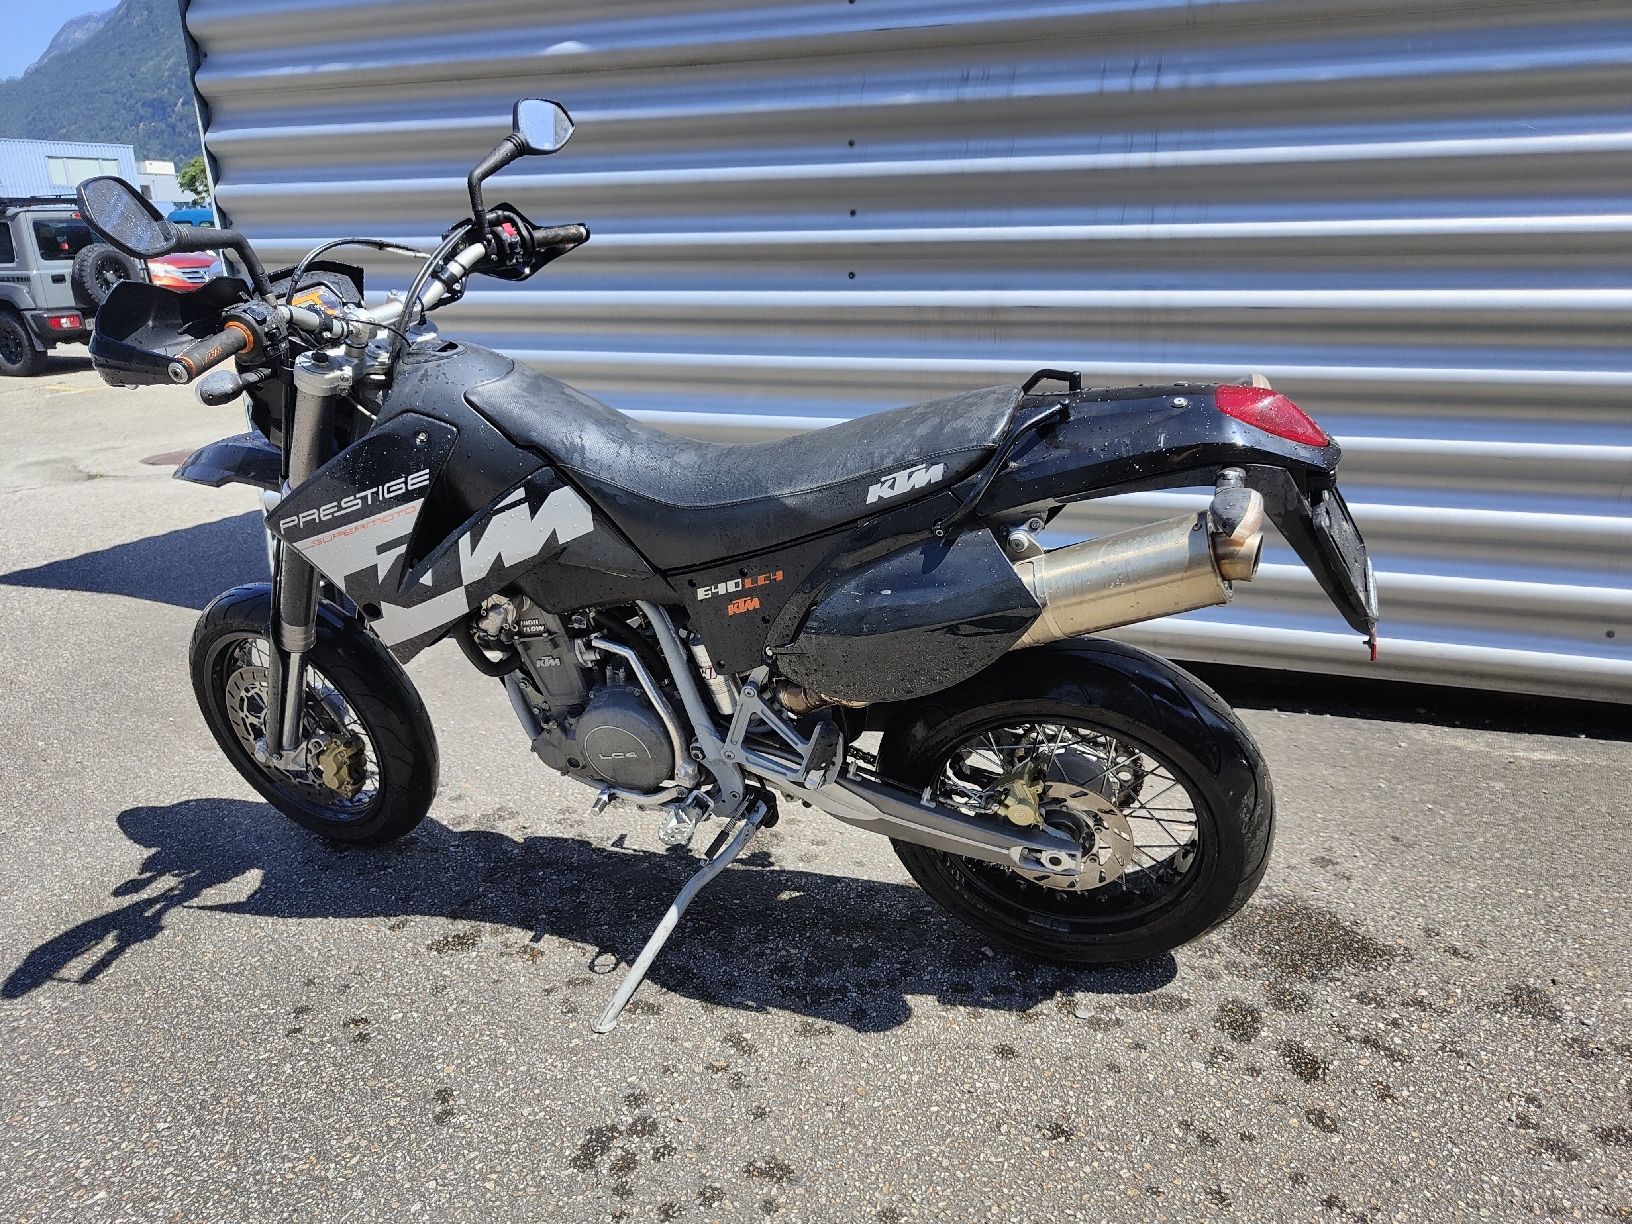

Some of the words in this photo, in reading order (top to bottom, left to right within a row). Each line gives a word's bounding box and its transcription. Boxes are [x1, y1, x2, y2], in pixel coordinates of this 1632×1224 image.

[866, 463, 944, 505] KTM
[279, 468, 430, 535] PRESTIGE
[311, 505, 416, 547] SUPERMOTO
[727, 596, 760, 616] KTM
[536, 656, 561, 668] KTM
[599, 751, 638, 760] LC4
